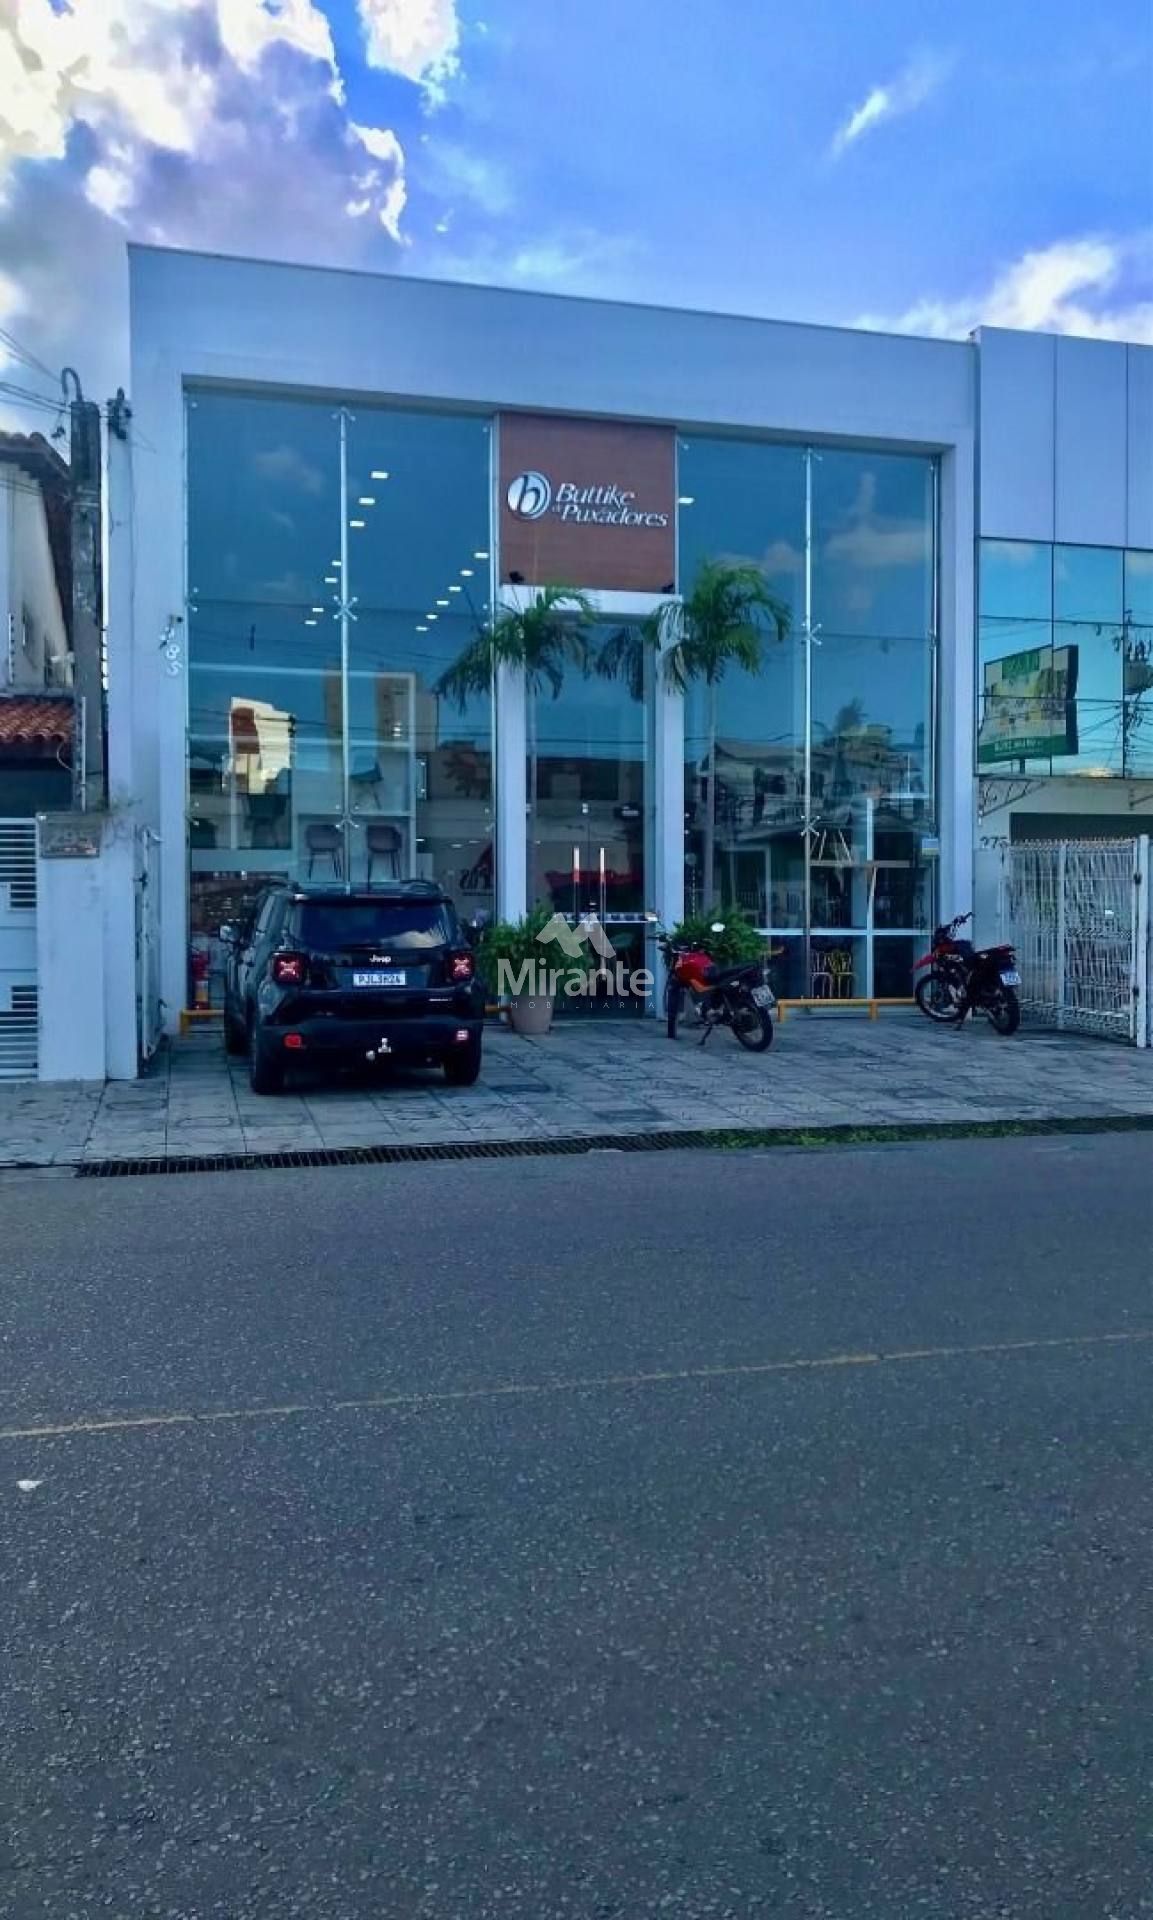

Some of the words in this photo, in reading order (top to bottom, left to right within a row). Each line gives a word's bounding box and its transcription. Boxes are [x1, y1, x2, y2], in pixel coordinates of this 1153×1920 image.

[555, 483, 636, 507] Buttike
[561, 504, 669, 527] Puxadores
[369, 954, 391, 963] Jeep
